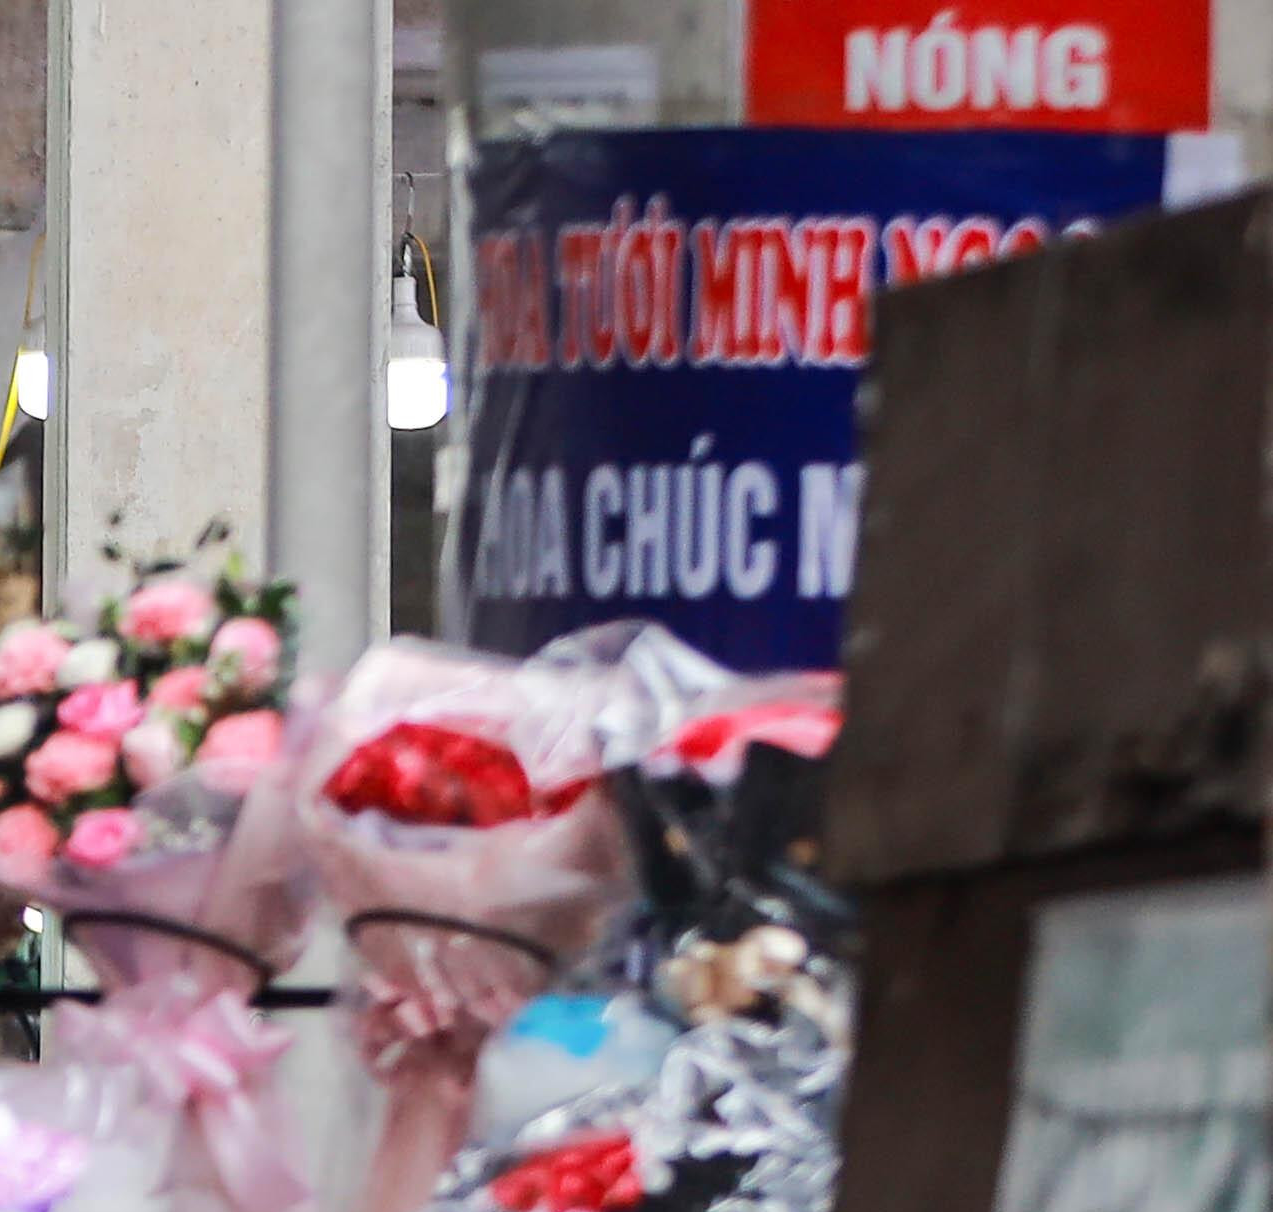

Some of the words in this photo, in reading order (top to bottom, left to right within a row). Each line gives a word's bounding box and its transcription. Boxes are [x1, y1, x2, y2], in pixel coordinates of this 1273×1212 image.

[844, 10, 1109, 112] NÓNG
[688, 217, 872, 368] MINH
[583, 433, 779, 600] CHÚC
